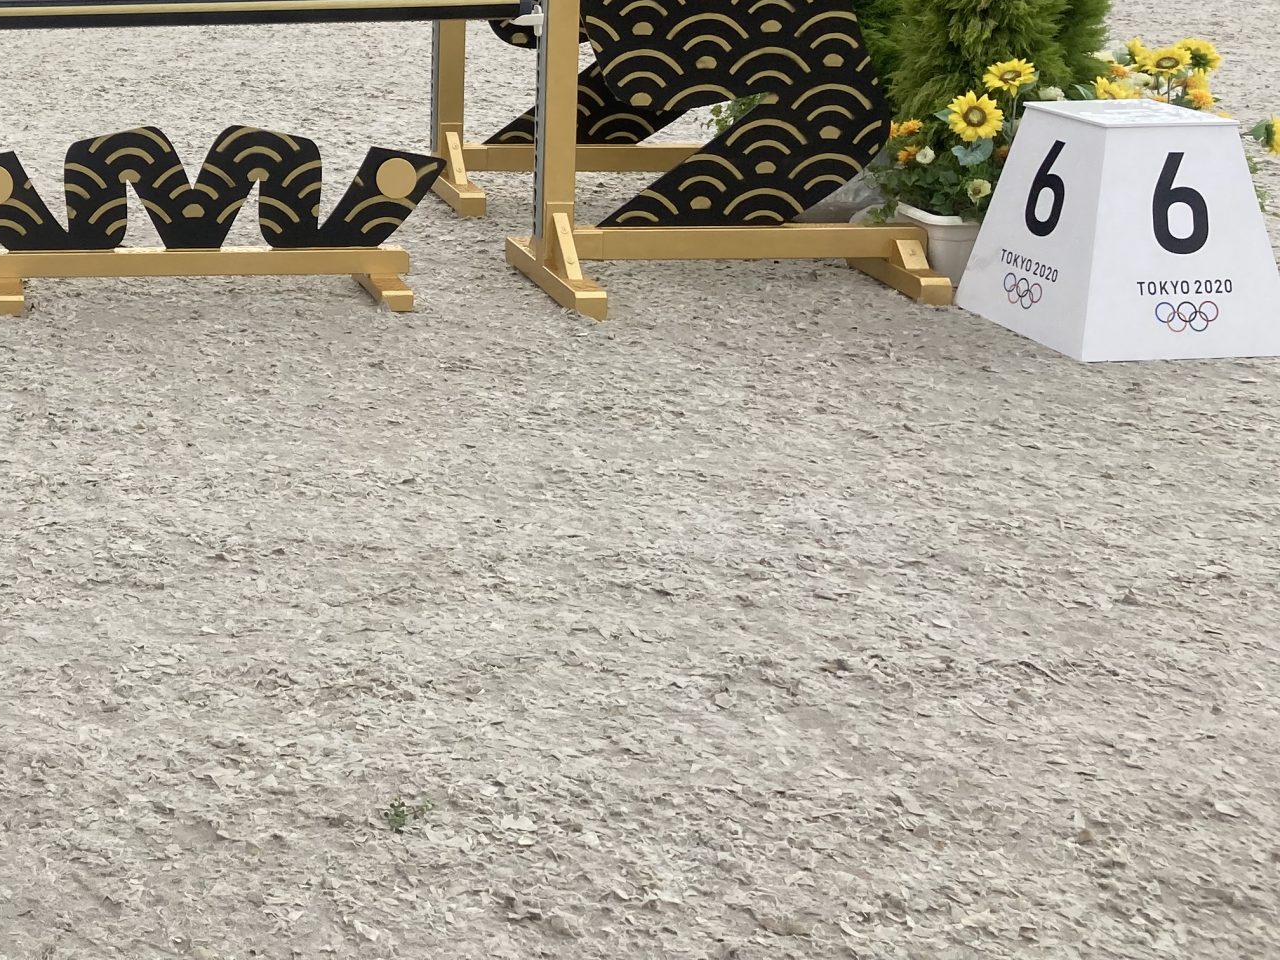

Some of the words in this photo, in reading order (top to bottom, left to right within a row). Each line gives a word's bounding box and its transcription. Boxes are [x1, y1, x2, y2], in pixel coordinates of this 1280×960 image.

[1024, 139, 1066, 237] 6
[1152, 151, 1209, 255] 6
[1000, 248, 1033, 272] TOKYO
[1032, 261, 1059, 283] 2020
[1136, 280, 1190, 296] TOKYO
[1194, 279, 1233, 294] 2020
